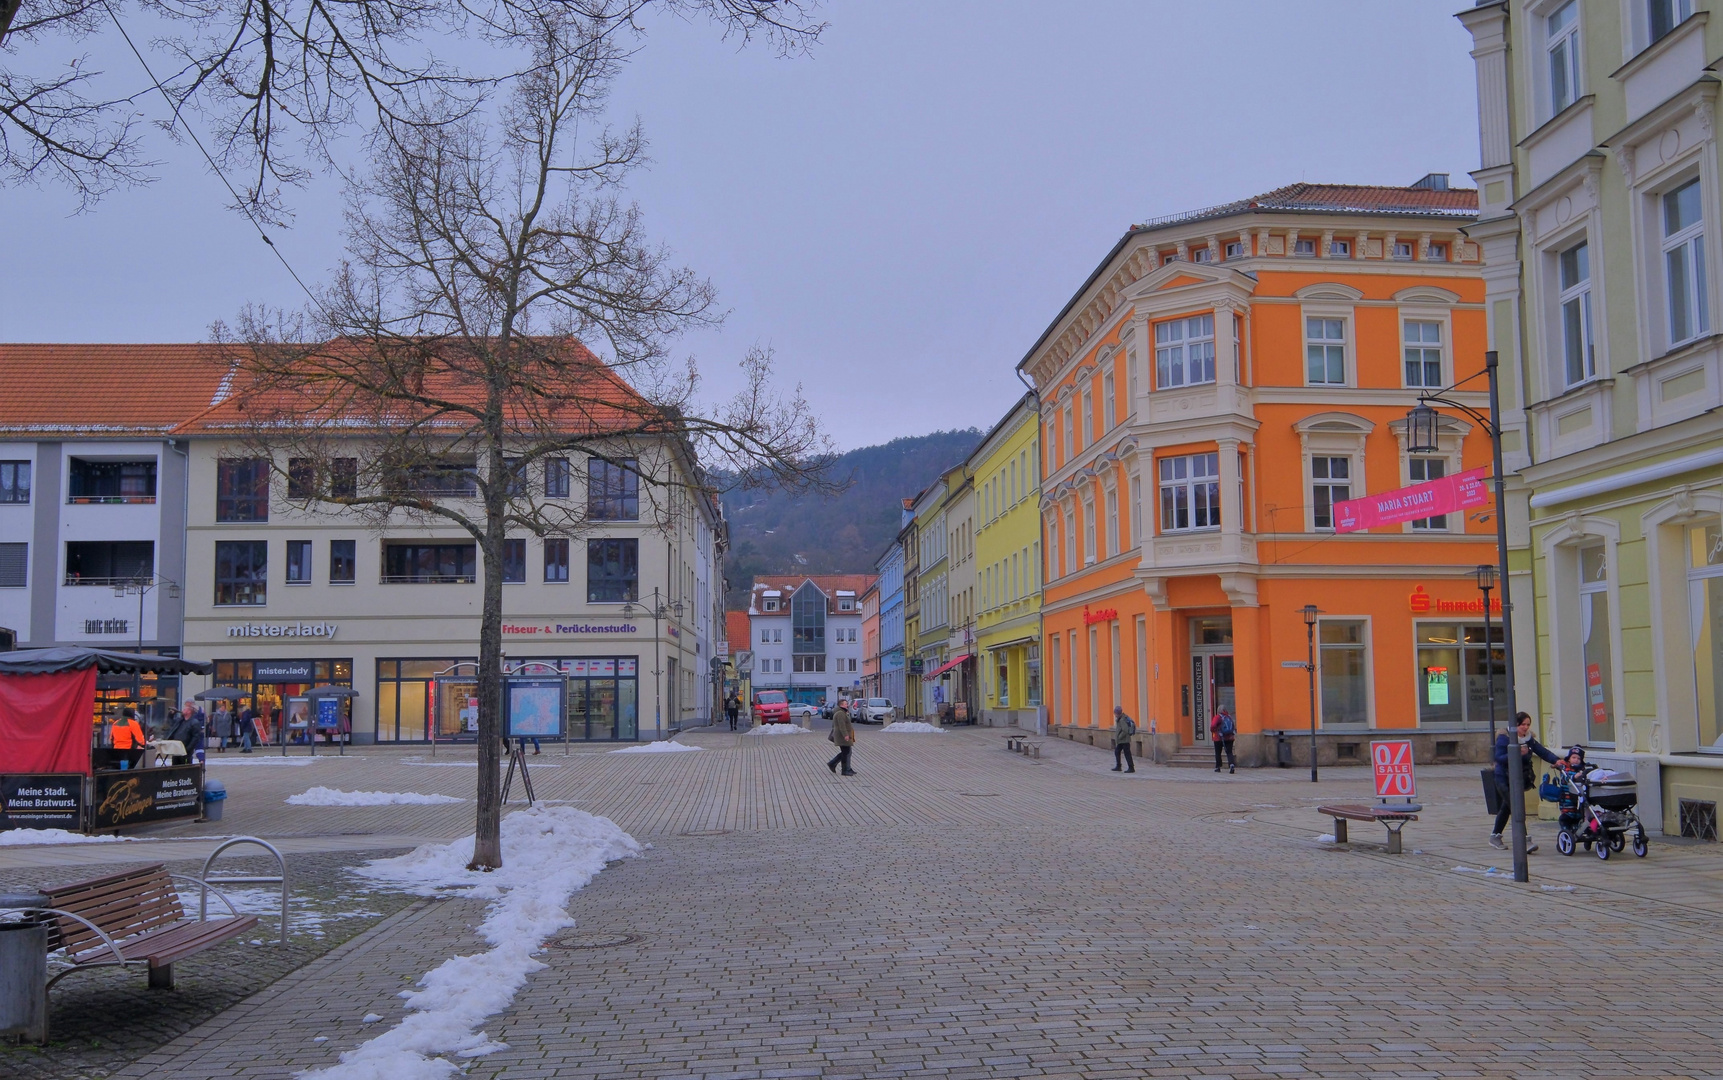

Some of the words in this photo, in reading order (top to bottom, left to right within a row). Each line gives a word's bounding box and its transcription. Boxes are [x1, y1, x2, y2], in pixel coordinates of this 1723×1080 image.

[1377, 498, 1402, 512] MARIA
[1403, 490, 1434, 506] STUART
[544, 626, 552, 634] &
[556, 624, 637, 634] Perückenstudio
[162, 780, 178, 788] Meine
[178, 778, 192, 786] Stadt.
[18, 788, 42, 796] Meine
[44, 787, 68, 796] Stadt.
[156, 790, 172, 799] Meine
[173, 788, 198, 798] Bratwurst.
[8, 799, 32, 807] Meine
[34, 798, 76, 807] Bratwurst.
[112, 796, 152, 824] Meininger
